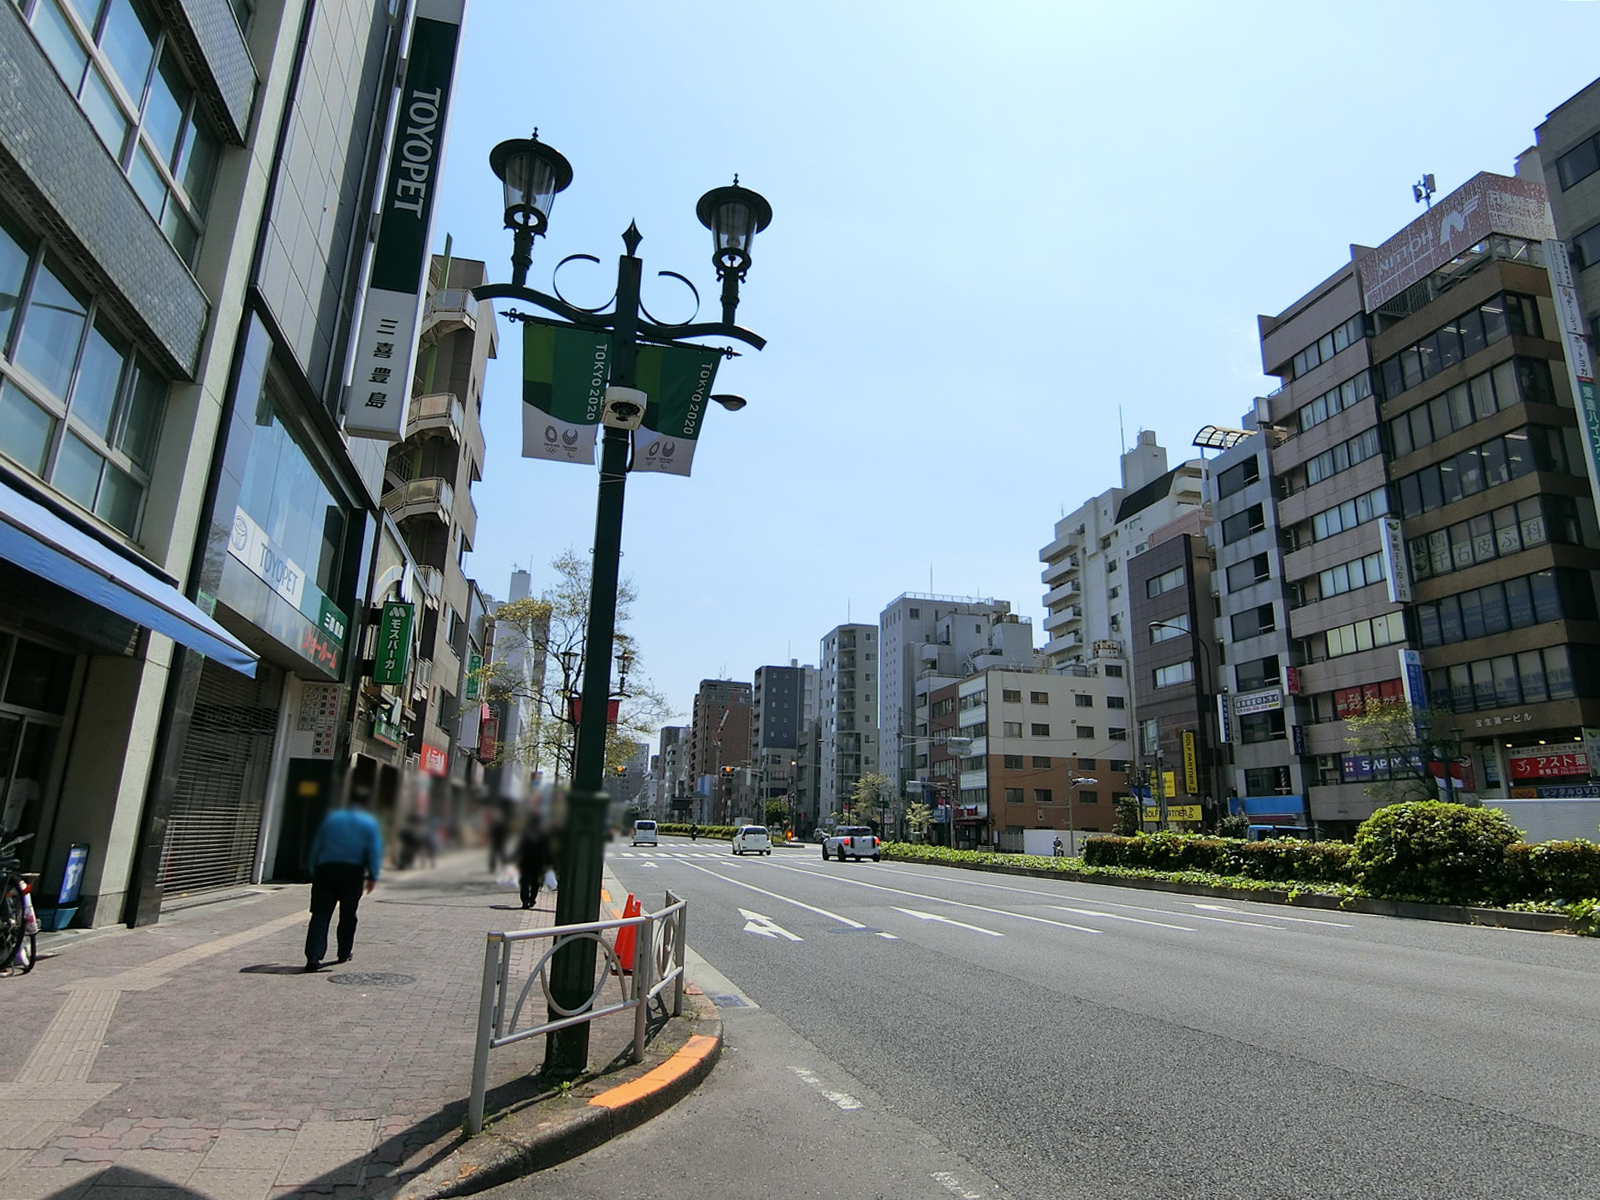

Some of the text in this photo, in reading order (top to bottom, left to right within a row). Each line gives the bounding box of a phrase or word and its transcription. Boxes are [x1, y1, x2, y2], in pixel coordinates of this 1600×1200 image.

[394, 87, 442, 219] TOYOPET
[364, 319, 399, 409] 三喜豊島
[586, 343, 608, 420] TOKYO 2020
[682, 362, 713, 435] TOKYO 2020
[259, 542, 299, 596] TOYOPET
[384, 619, 402, 680] モスバーガー
[1361, 757, 1402, 771] SAPIX
